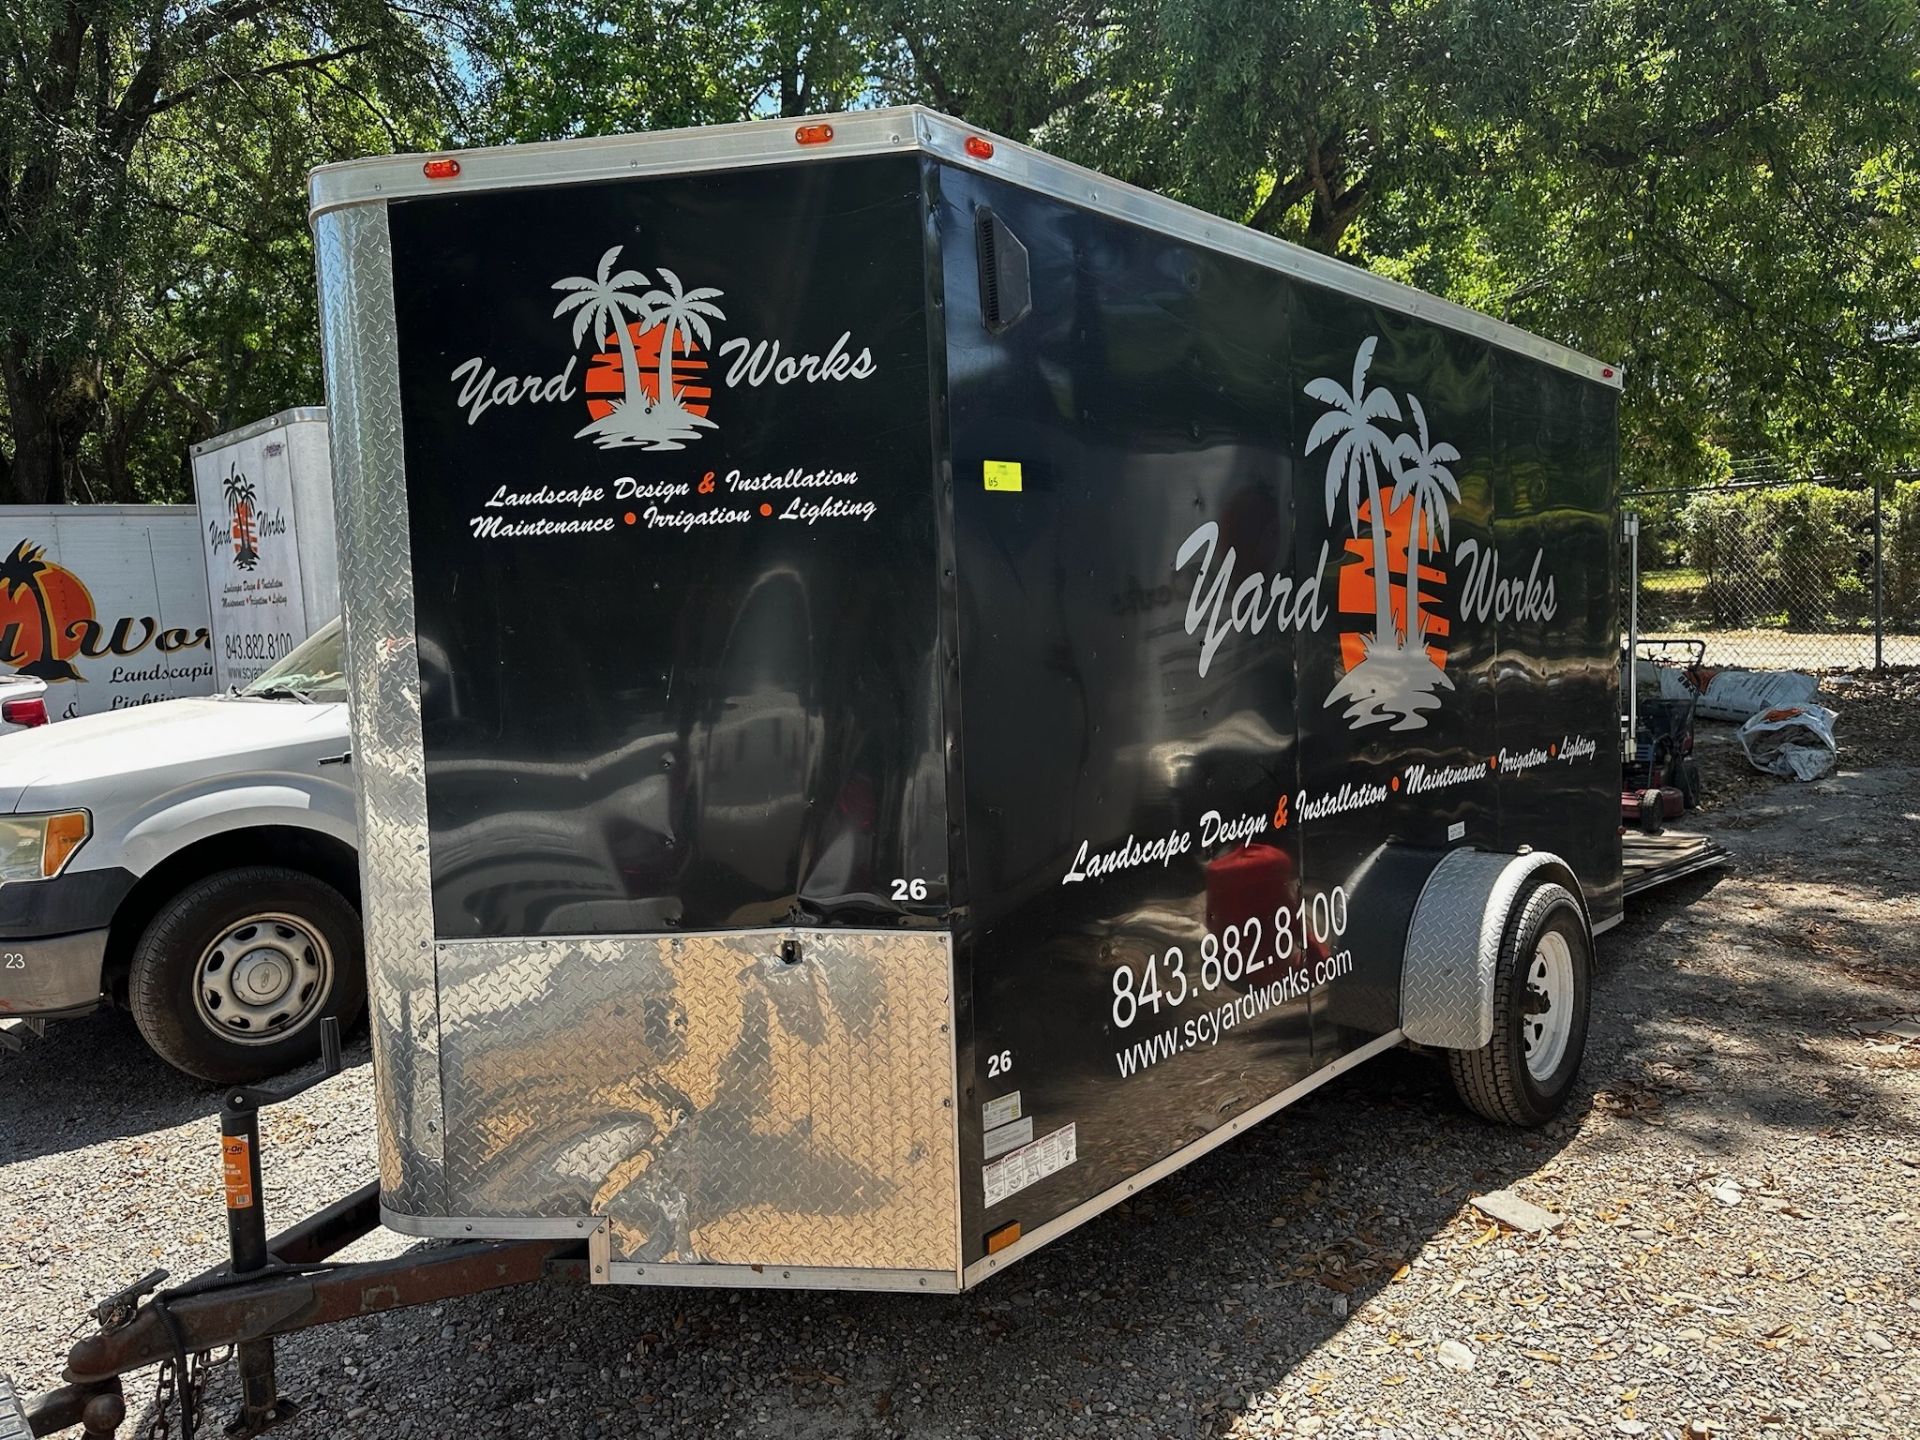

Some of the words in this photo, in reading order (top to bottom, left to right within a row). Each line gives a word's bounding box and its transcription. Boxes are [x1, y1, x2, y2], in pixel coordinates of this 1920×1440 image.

[451, 356, 577, 425] Yard
[718, 331, 877, 387] Works
[485, 485, 604, 508] Landscape
[613, 476, 690, 503] Design
[698, 471, 716, 495] &
[725, 468, 858, 493] Installation
[209, 520, 232, 555] Yard
[257, 507, 286, 537] Works
[469, 515, 615, 539] Maintenance
[643, 505, 751, 533] Irrigation
[778, 497, 877, 522] Lighting
[1175, 521, 1329, 678] Yard
[1455, 538, 1558, 623] Works
[225, 632, 294, 660] 843.882.8100
[1062, 829, 1192, 885] Landscape
[1200, 809, 1268, 848] Design
[1273, 794, 1288, 829] &
[1295, 782, 1388, 823] Installation
[1405, 763, 1487, 795] Maintenance
[1498, 747, 1548, 778] Irrigation
[1558, 734, 1596, 766] Lighting
[890, 878, 927, 901] 26
[4, 953, 26, 969] 23
[1112, 885, 1348, 1028] 843.882.8100
[1115, 949, 1353, 1079] www.scyardworks.com
[987, 1049, 1013, 1079] 26
